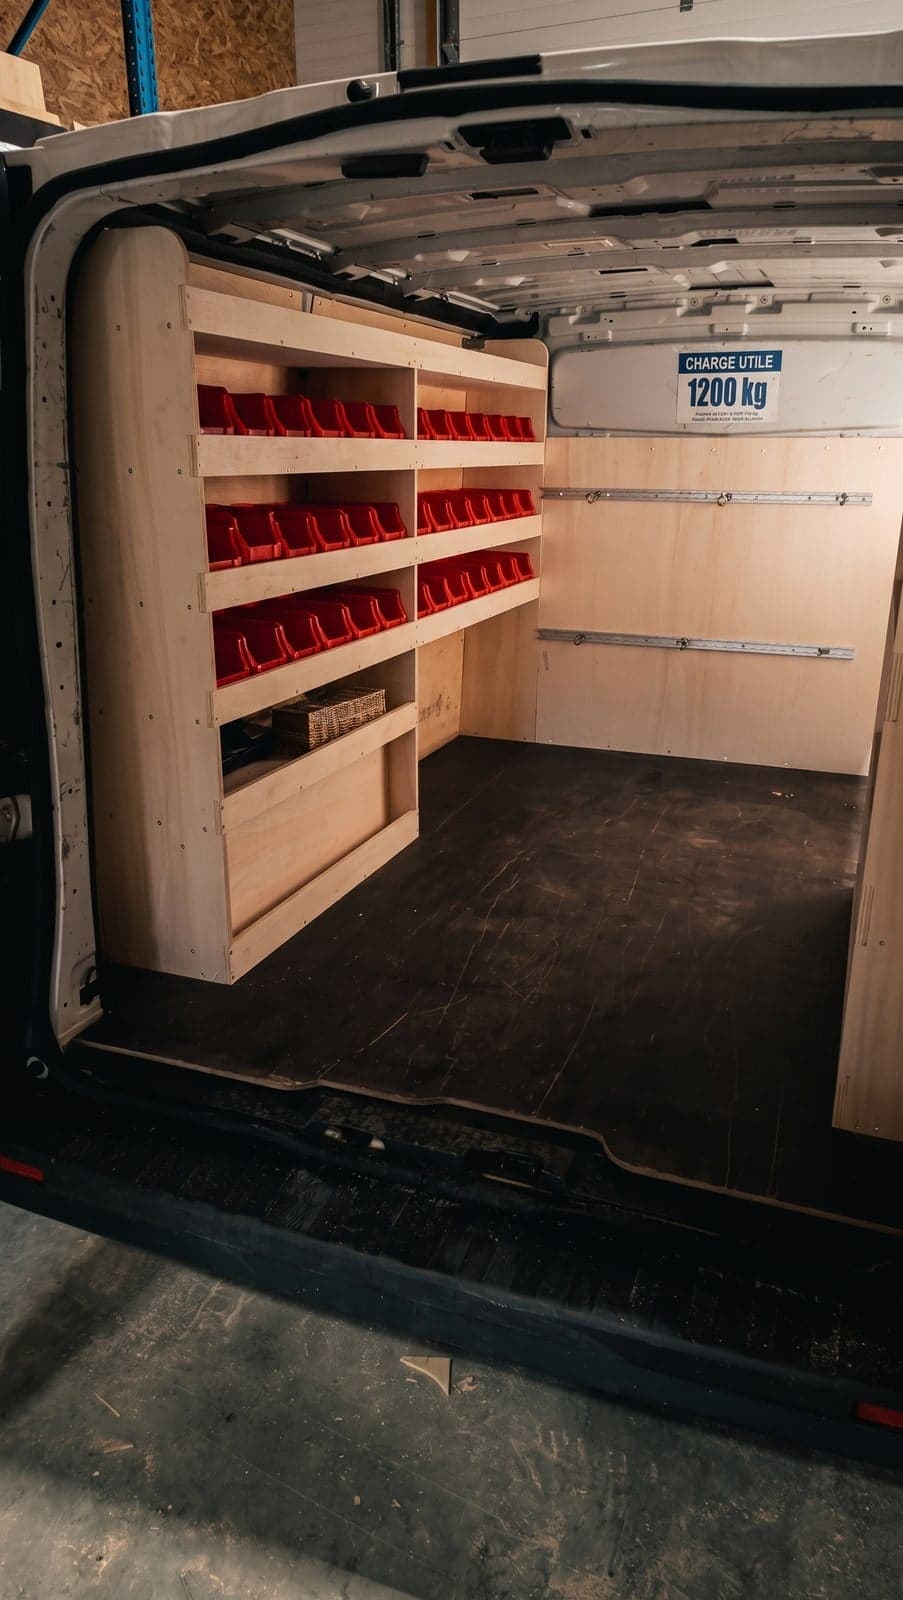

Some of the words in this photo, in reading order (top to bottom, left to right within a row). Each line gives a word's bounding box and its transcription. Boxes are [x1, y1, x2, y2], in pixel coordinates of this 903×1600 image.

[685, 356, 736, 370] CHARGE
[739, 354, 774, 369] UTILE
[688, 377, 737, 407] 1200
[741, 377, 768, 410] kg
